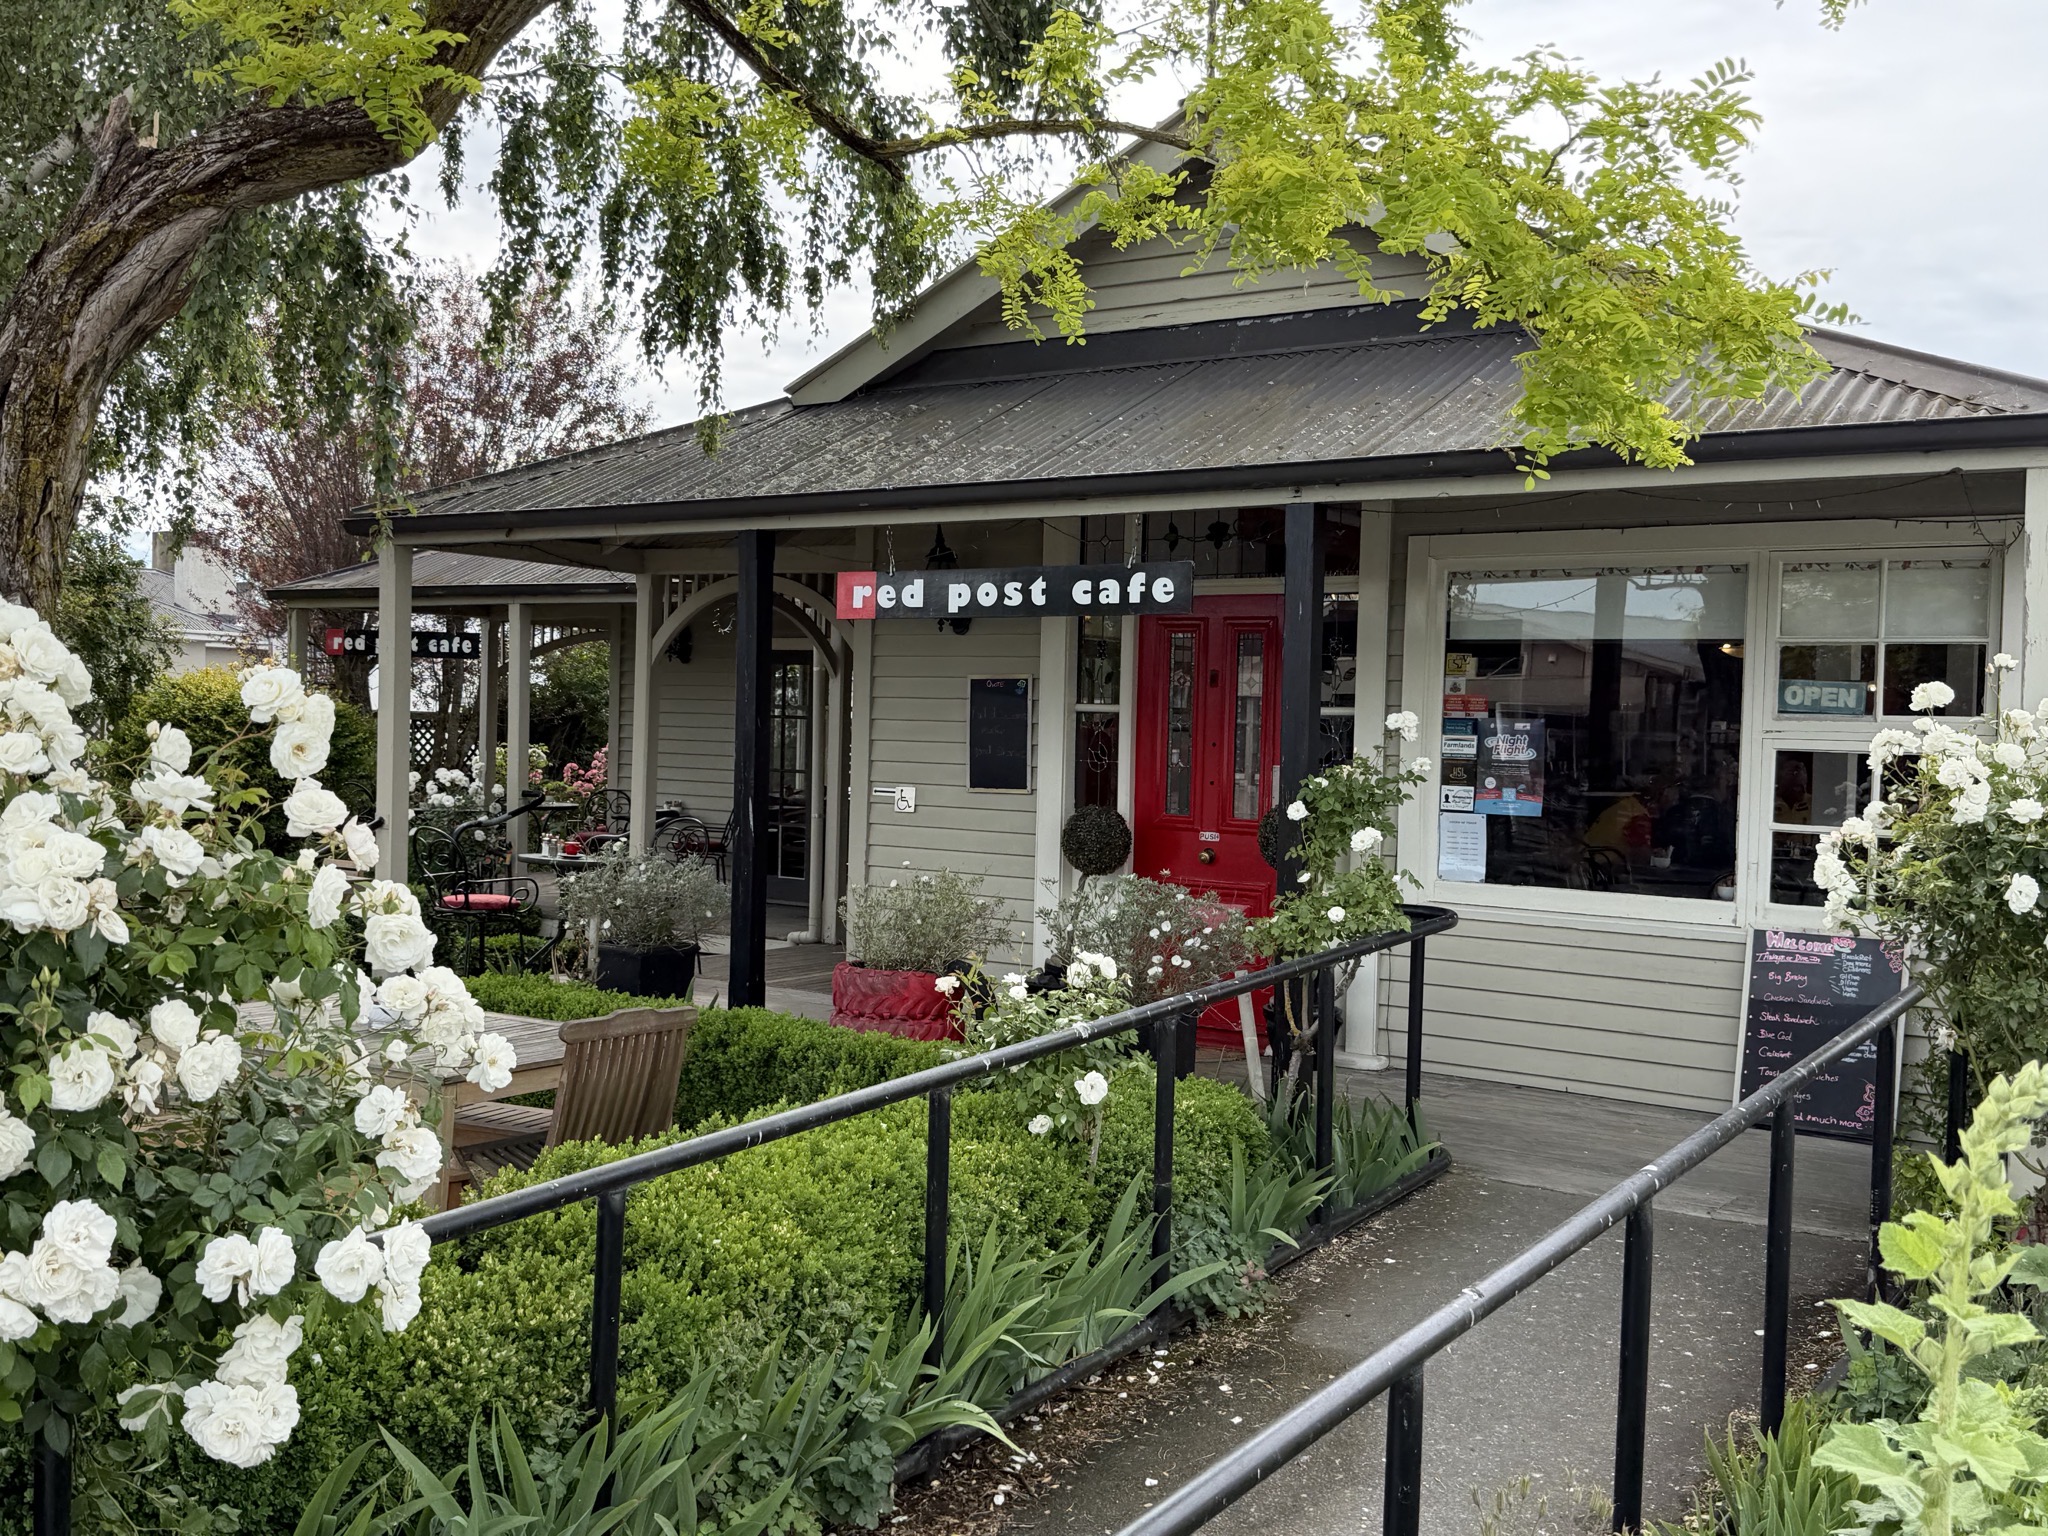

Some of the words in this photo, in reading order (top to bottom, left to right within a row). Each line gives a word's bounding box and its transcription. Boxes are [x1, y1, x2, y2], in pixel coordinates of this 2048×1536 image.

[852, 579, 924, 609] red
[948, 575, 1047, 613] post
[1072, 572, 1175, 605] cafe
[333, 635, 366, 650] red
[428, 637, 472, 654] cafe
[1784, 685, 1857, 708] OPEN
[1496, 735, 1528, 746] Night
[1493, 744, 1526, 756] Flight
[1768, 971, 1782, 985] Big
[1797, 993, 1834, 1007] Sandwich
[1759, 1011, 1780, 1021] Steak
[1783, 1013, 1819, 1025] Sandwich
[1777, 1031, 1792, 1041] Cod
